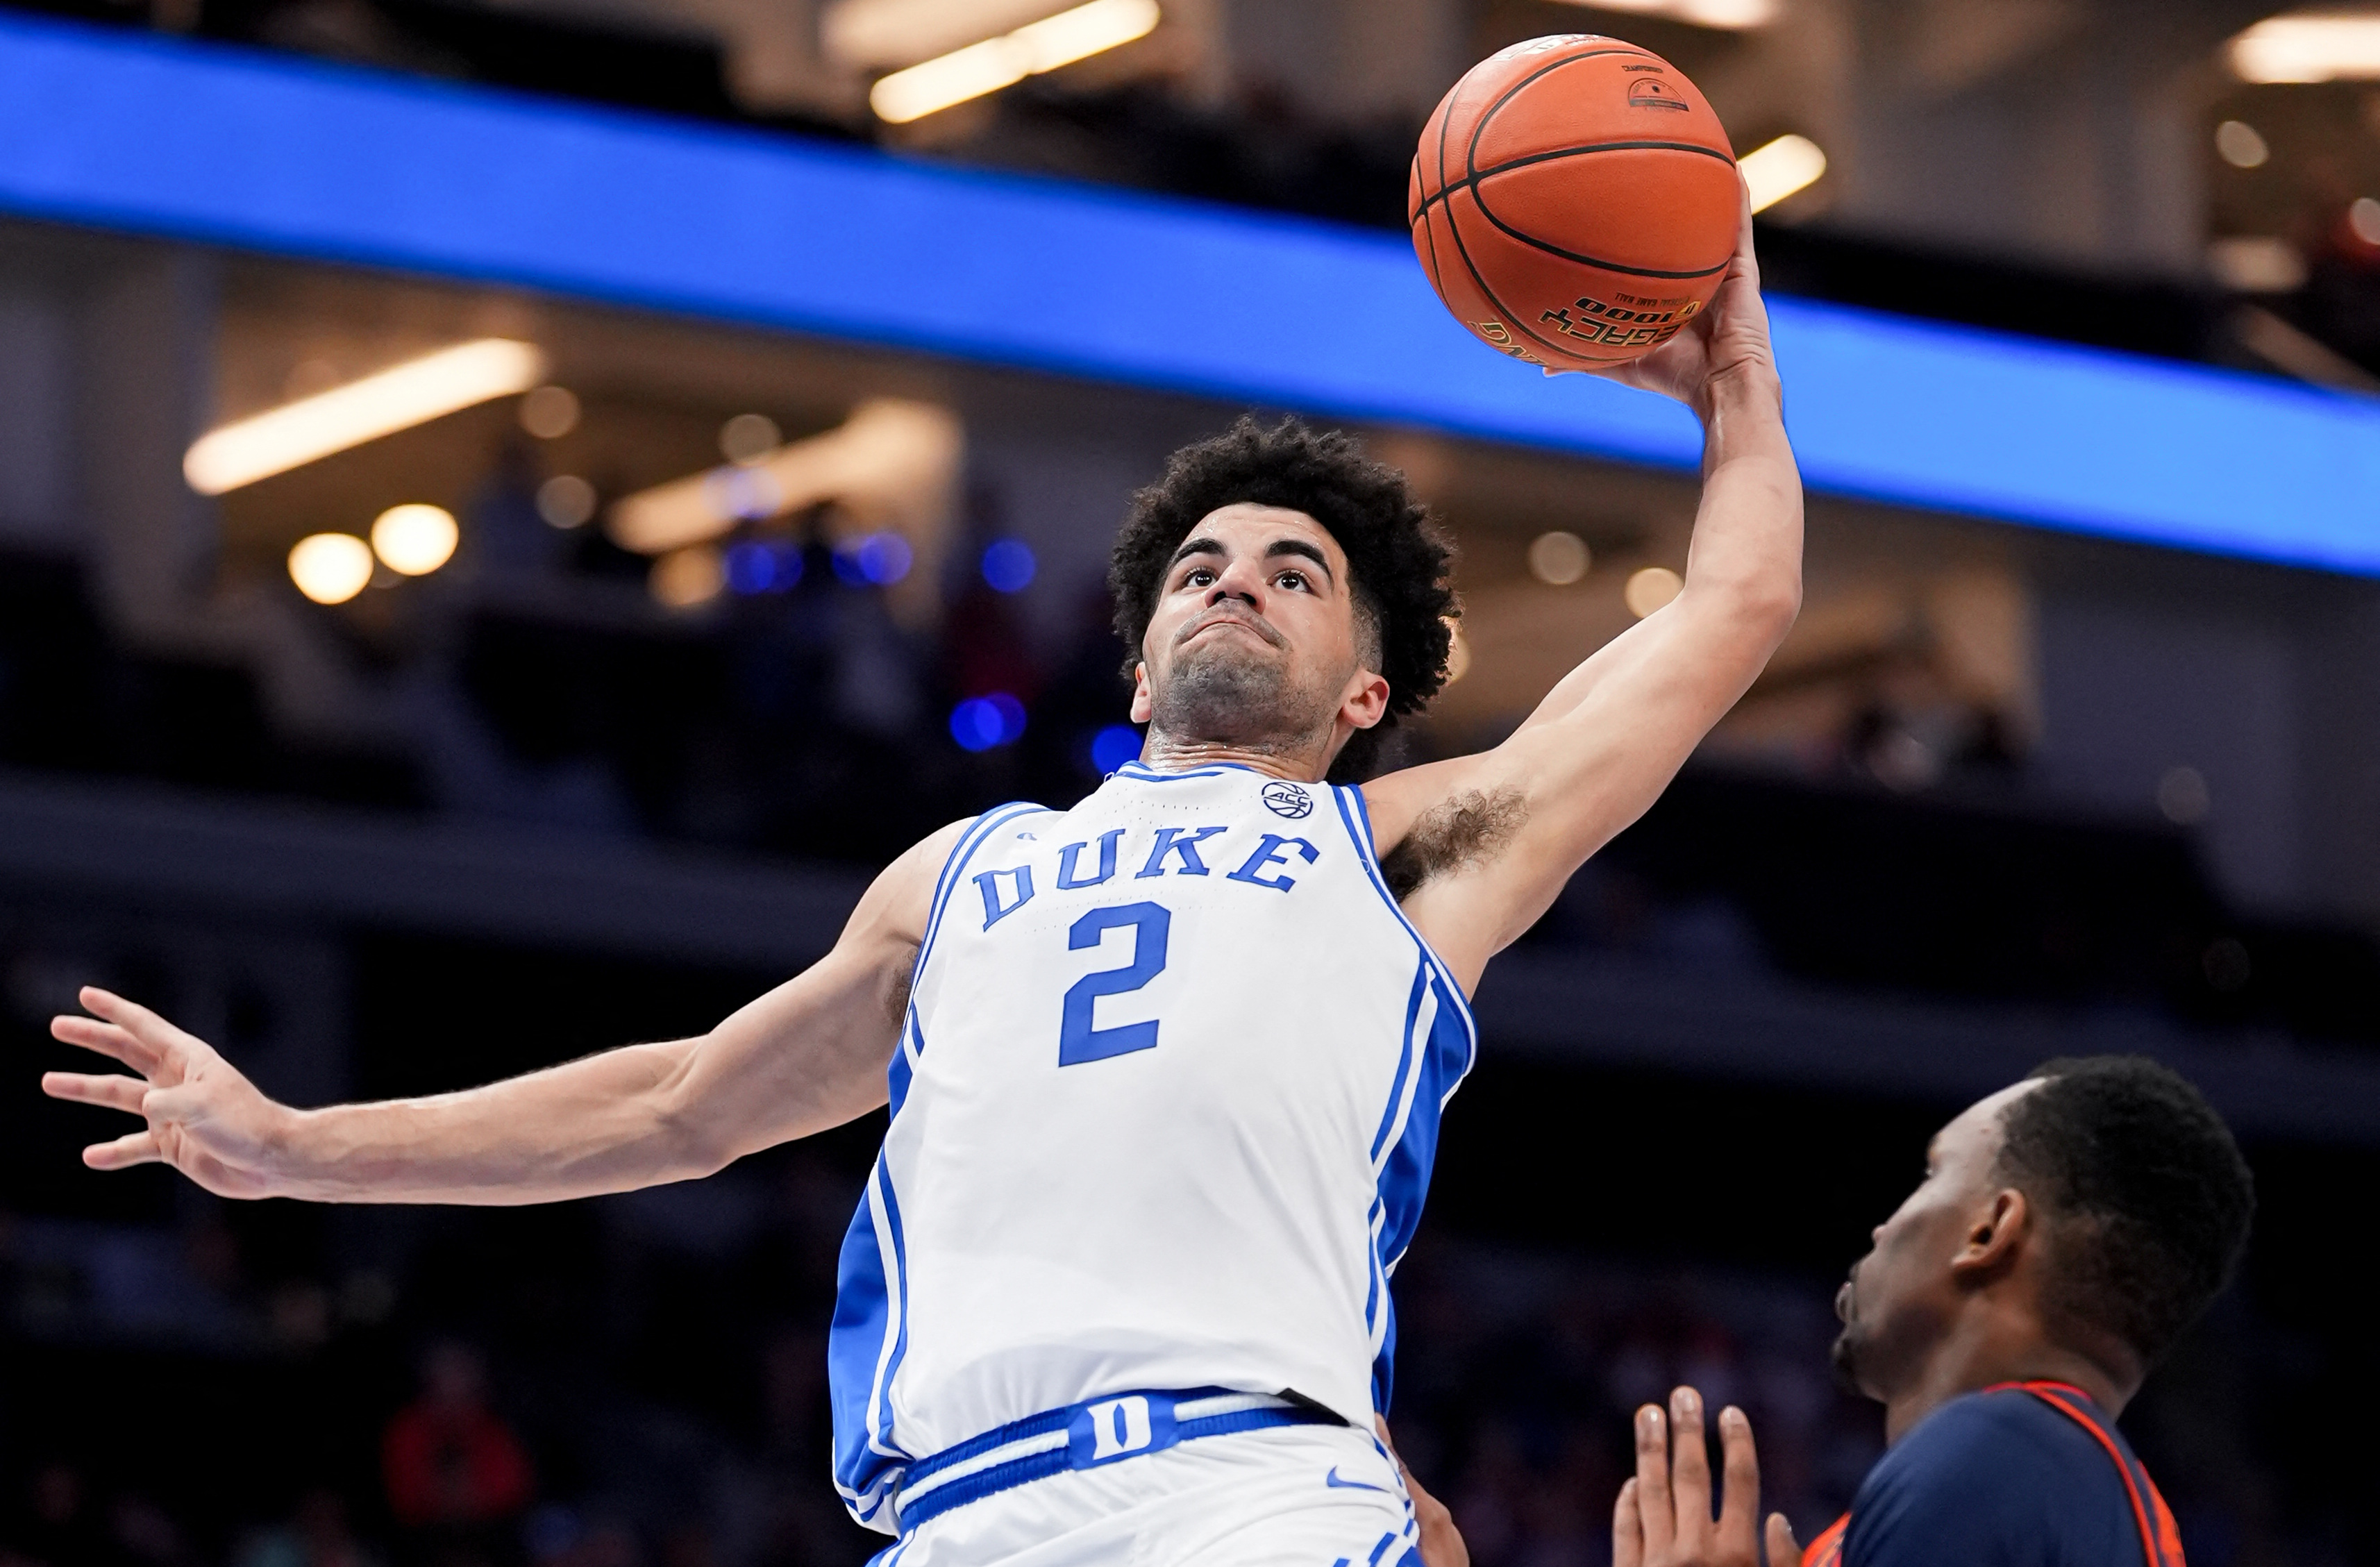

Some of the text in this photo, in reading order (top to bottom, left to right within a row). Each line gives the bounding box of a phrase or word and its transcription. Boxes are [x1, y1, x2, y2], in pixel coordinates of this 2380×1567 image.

[1573, 296, 1675, 324] 1000
[1614, 292, 1635, 303] BALL
[1635, 297, 1658, 306] GAME
[1537, 307, 1689, 346] EGACY
[1268, 791, 1310, 806] ACC
[973, 826, 1321, 932] DUKE
[1059, 901, 1171, 1067] 2
[1087, 1395, 1152, 1460] D
